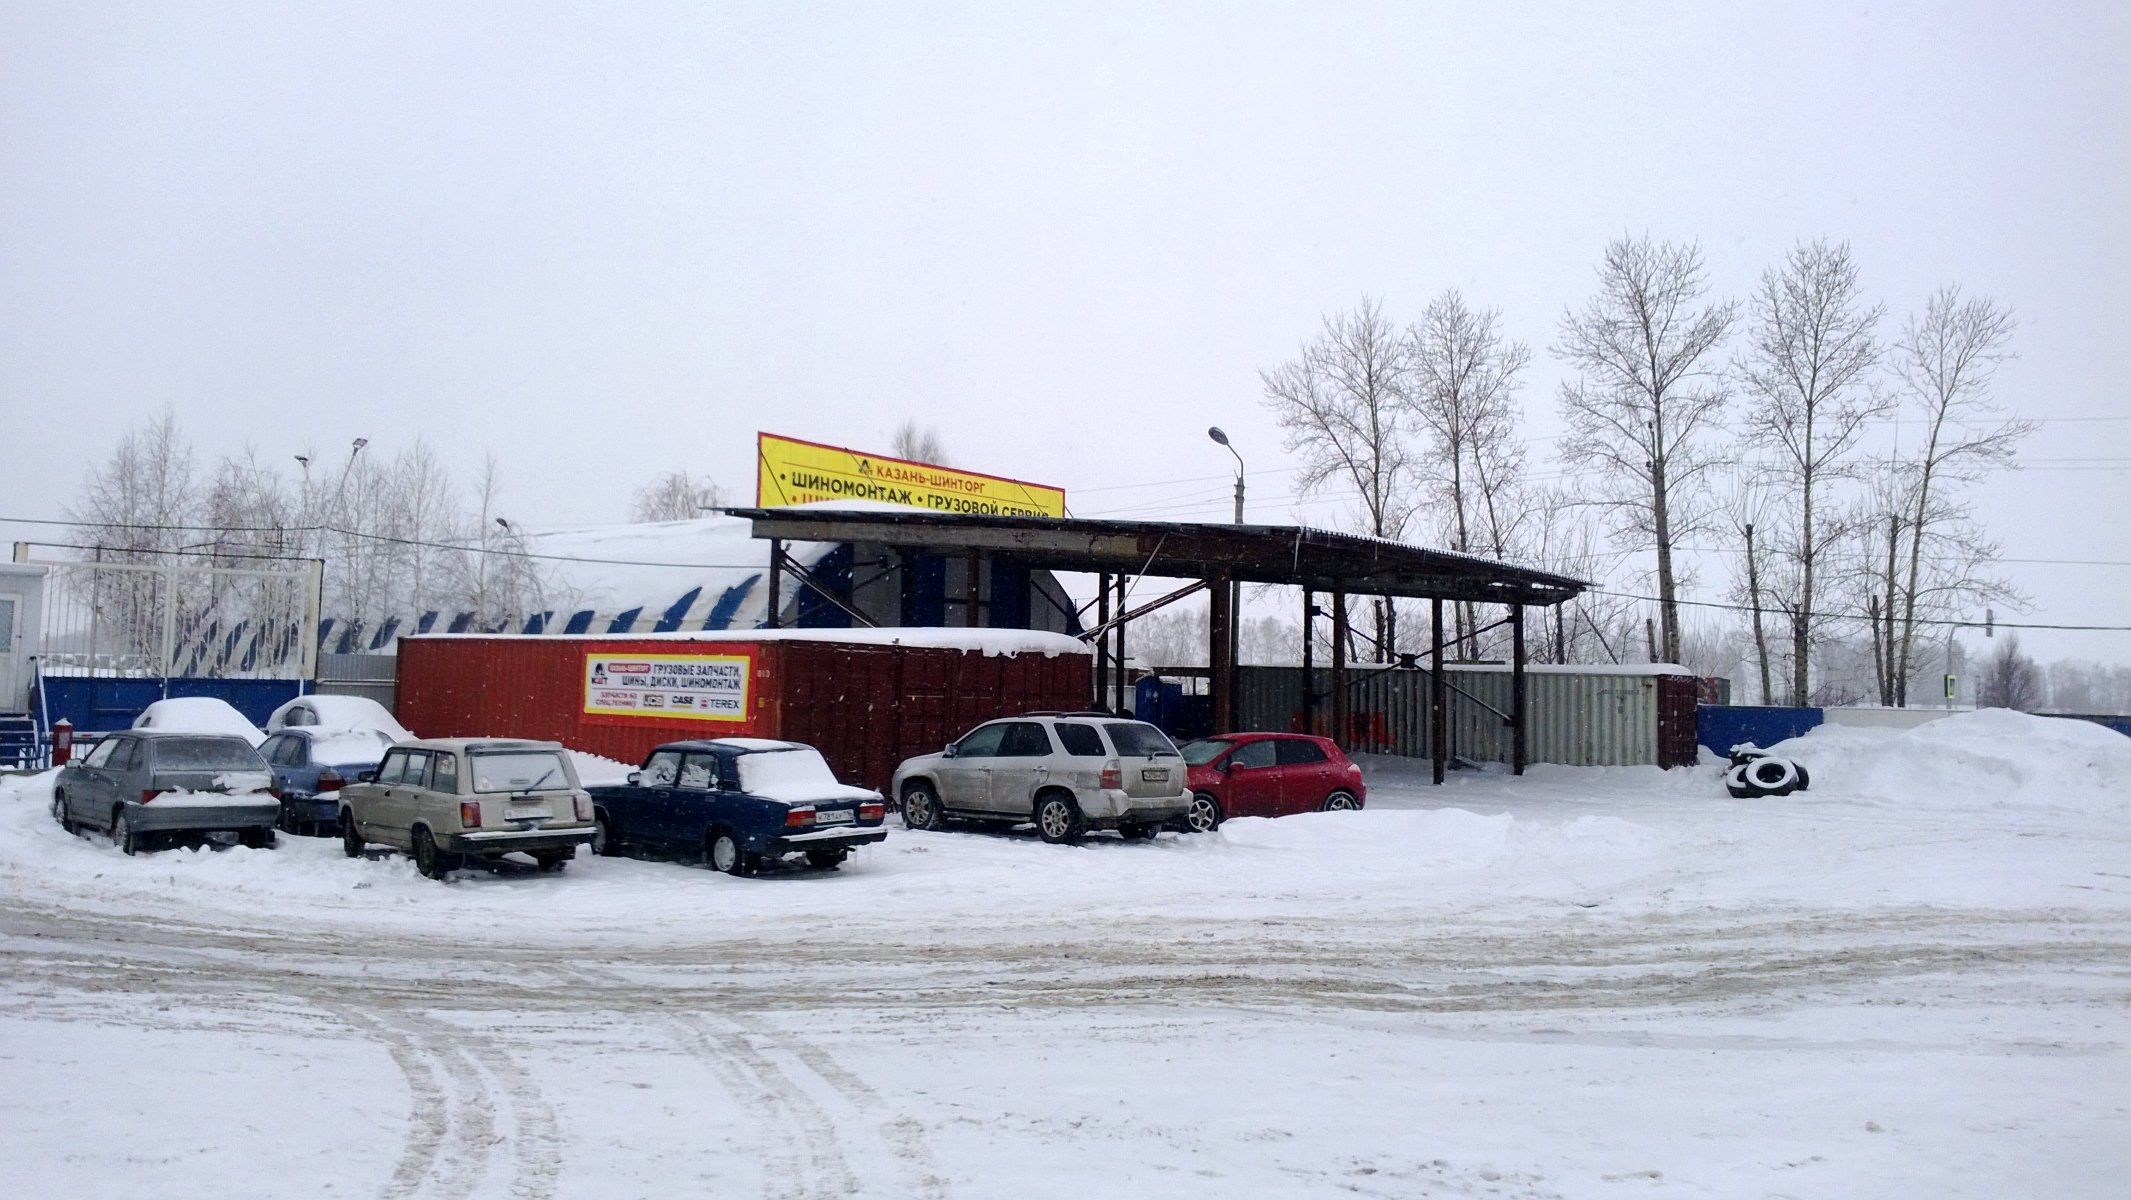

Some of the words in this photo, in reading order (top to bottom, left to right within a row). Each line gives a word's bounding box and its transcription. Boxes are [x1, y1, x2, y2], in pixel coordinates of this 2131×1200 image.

[876, 465, 986, 493] КАЗАНЬ-ШИНТОРГ
[792, 471, 913, 505] ШИНОМОНТАЖ
[927, 493, 999, 515] ГРУЗОВОЙ
[653, 664, 695, 676] ГРУЗОВЫЕ
[680, 677, 741, 689] ШИНОМОНТАЖ
[672, 695, 694, 705] CASE
[710, 699, 740, 709] TEREX
